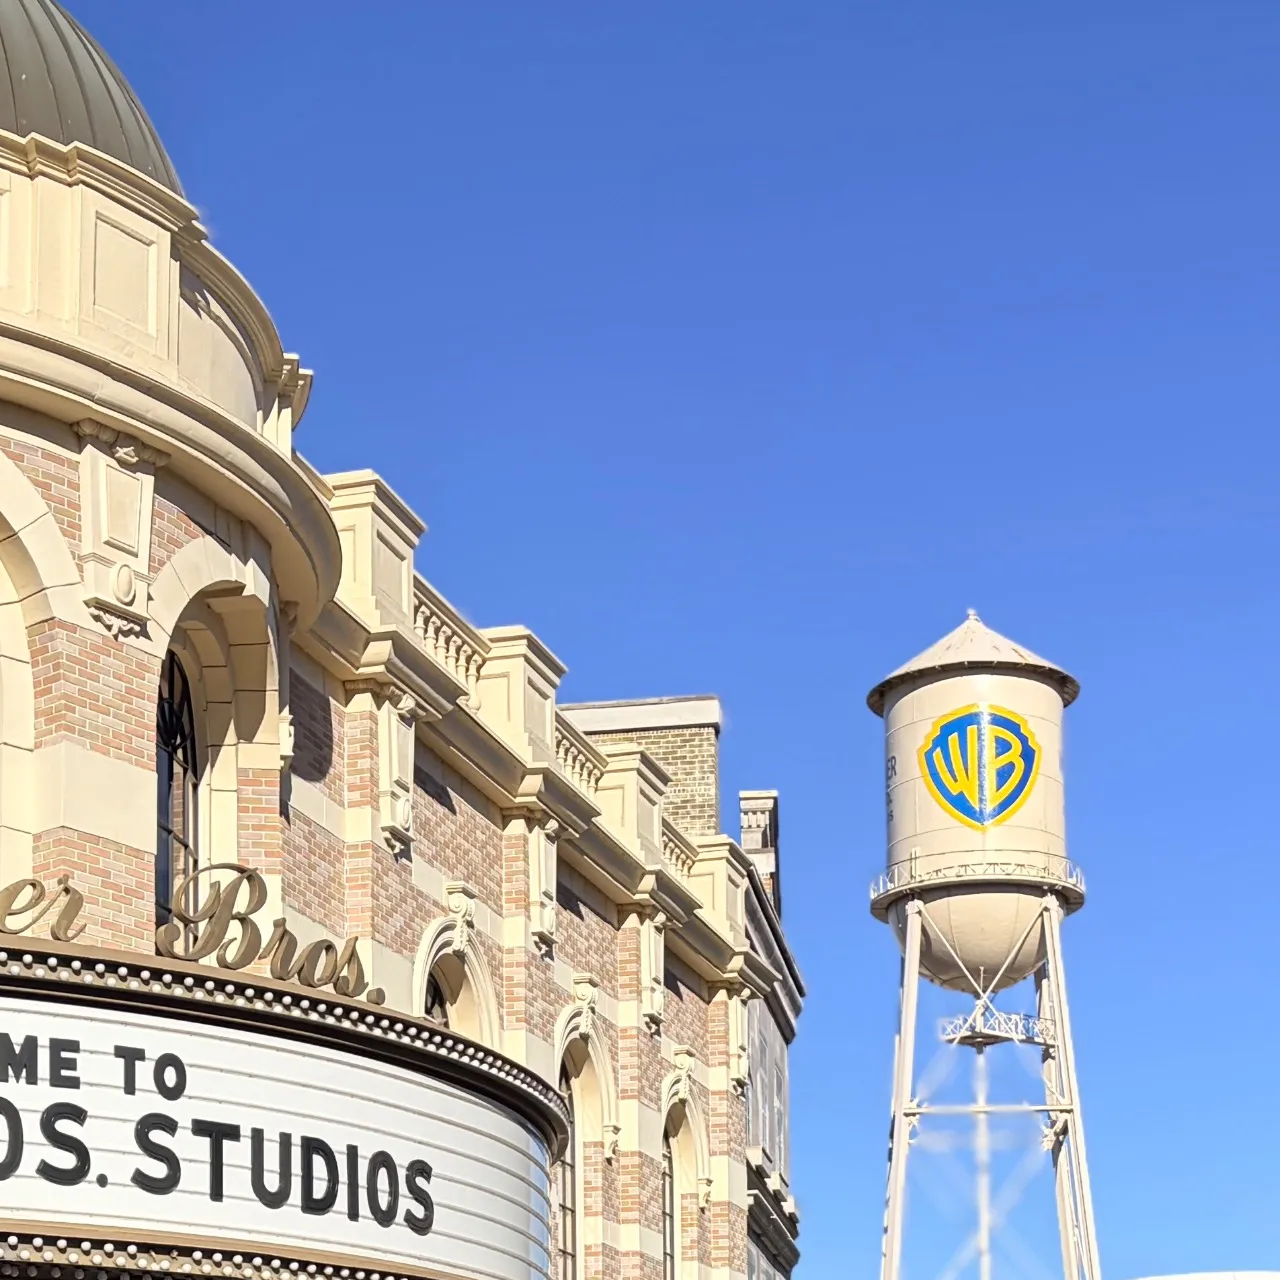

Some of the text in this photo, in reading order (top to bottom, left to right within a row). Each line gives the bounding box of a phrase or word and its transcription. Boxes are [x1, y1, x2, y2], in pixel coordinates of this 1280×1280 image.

[932, 724, 1026, 813] WB
[155, 862, 386, 1006] Bros.
[114, 1044, 188, 1101] TO
[130, 1112, 435, 1236] STUDIOS
